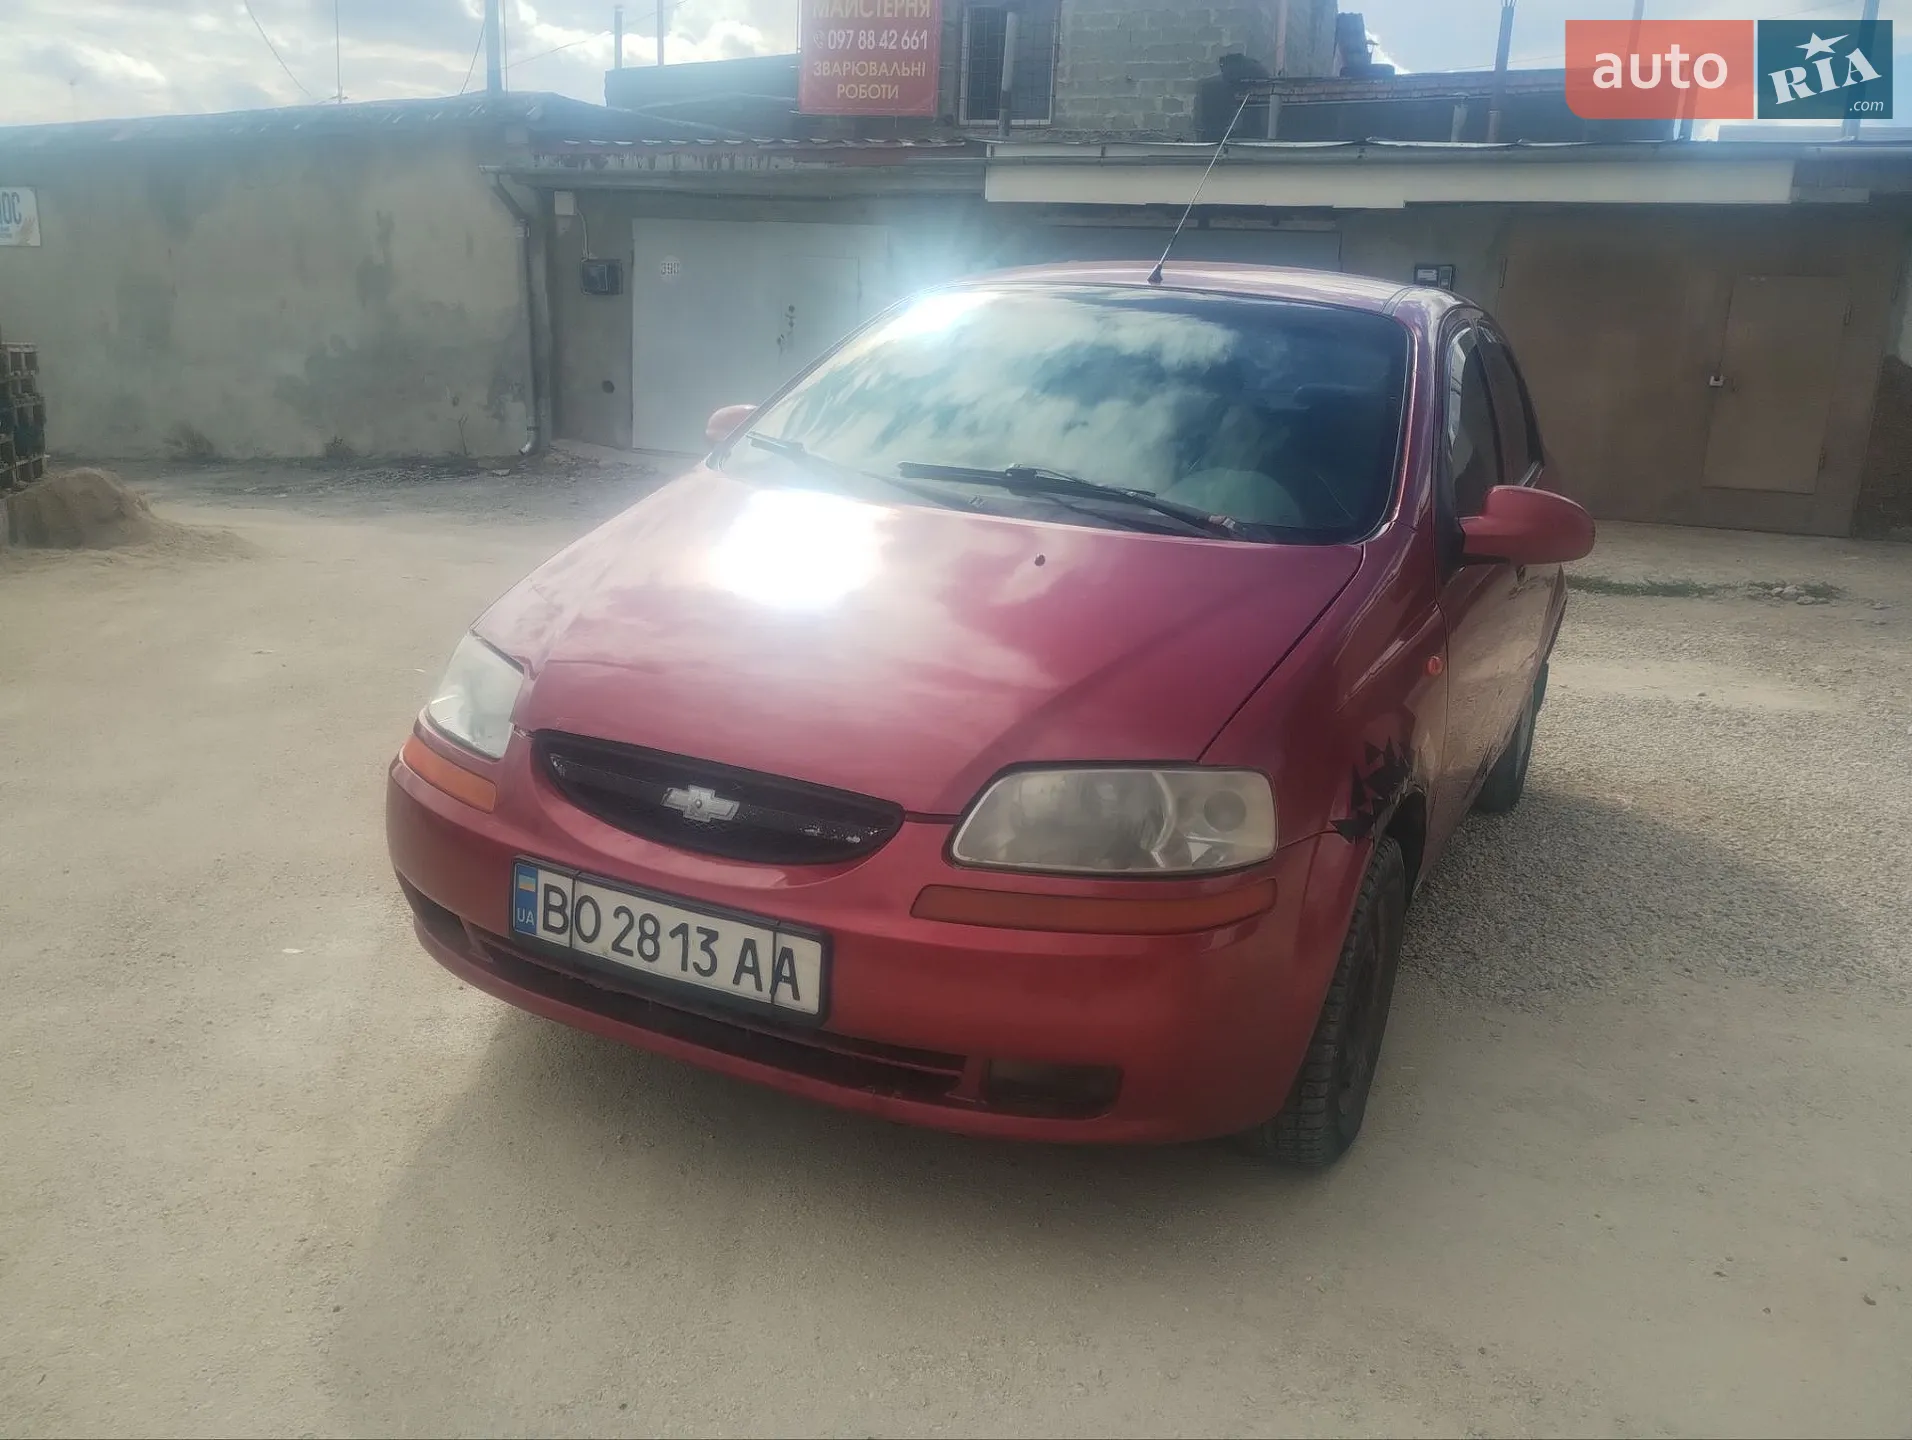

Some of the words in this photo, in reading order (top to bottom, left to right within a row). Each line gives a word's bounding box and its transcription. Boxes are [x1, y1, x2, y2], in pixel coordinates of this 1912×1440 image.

[827, 29, 854, 50] 097
[858, 29, 876, 50] 88
[879, 29, 898, 50] 42
[900, 29, 929, 50] 661
[813, 61, 926, 77] ЗВАРЮВАЛЬНІ
[837, 83, 900, 99] РОБОТИ
[516, 907, 535, 926] UA
[542, 883, 601, 944] BO
[611, 905, 719, 978] 2813
[732, 937, 801, 1001] AA
